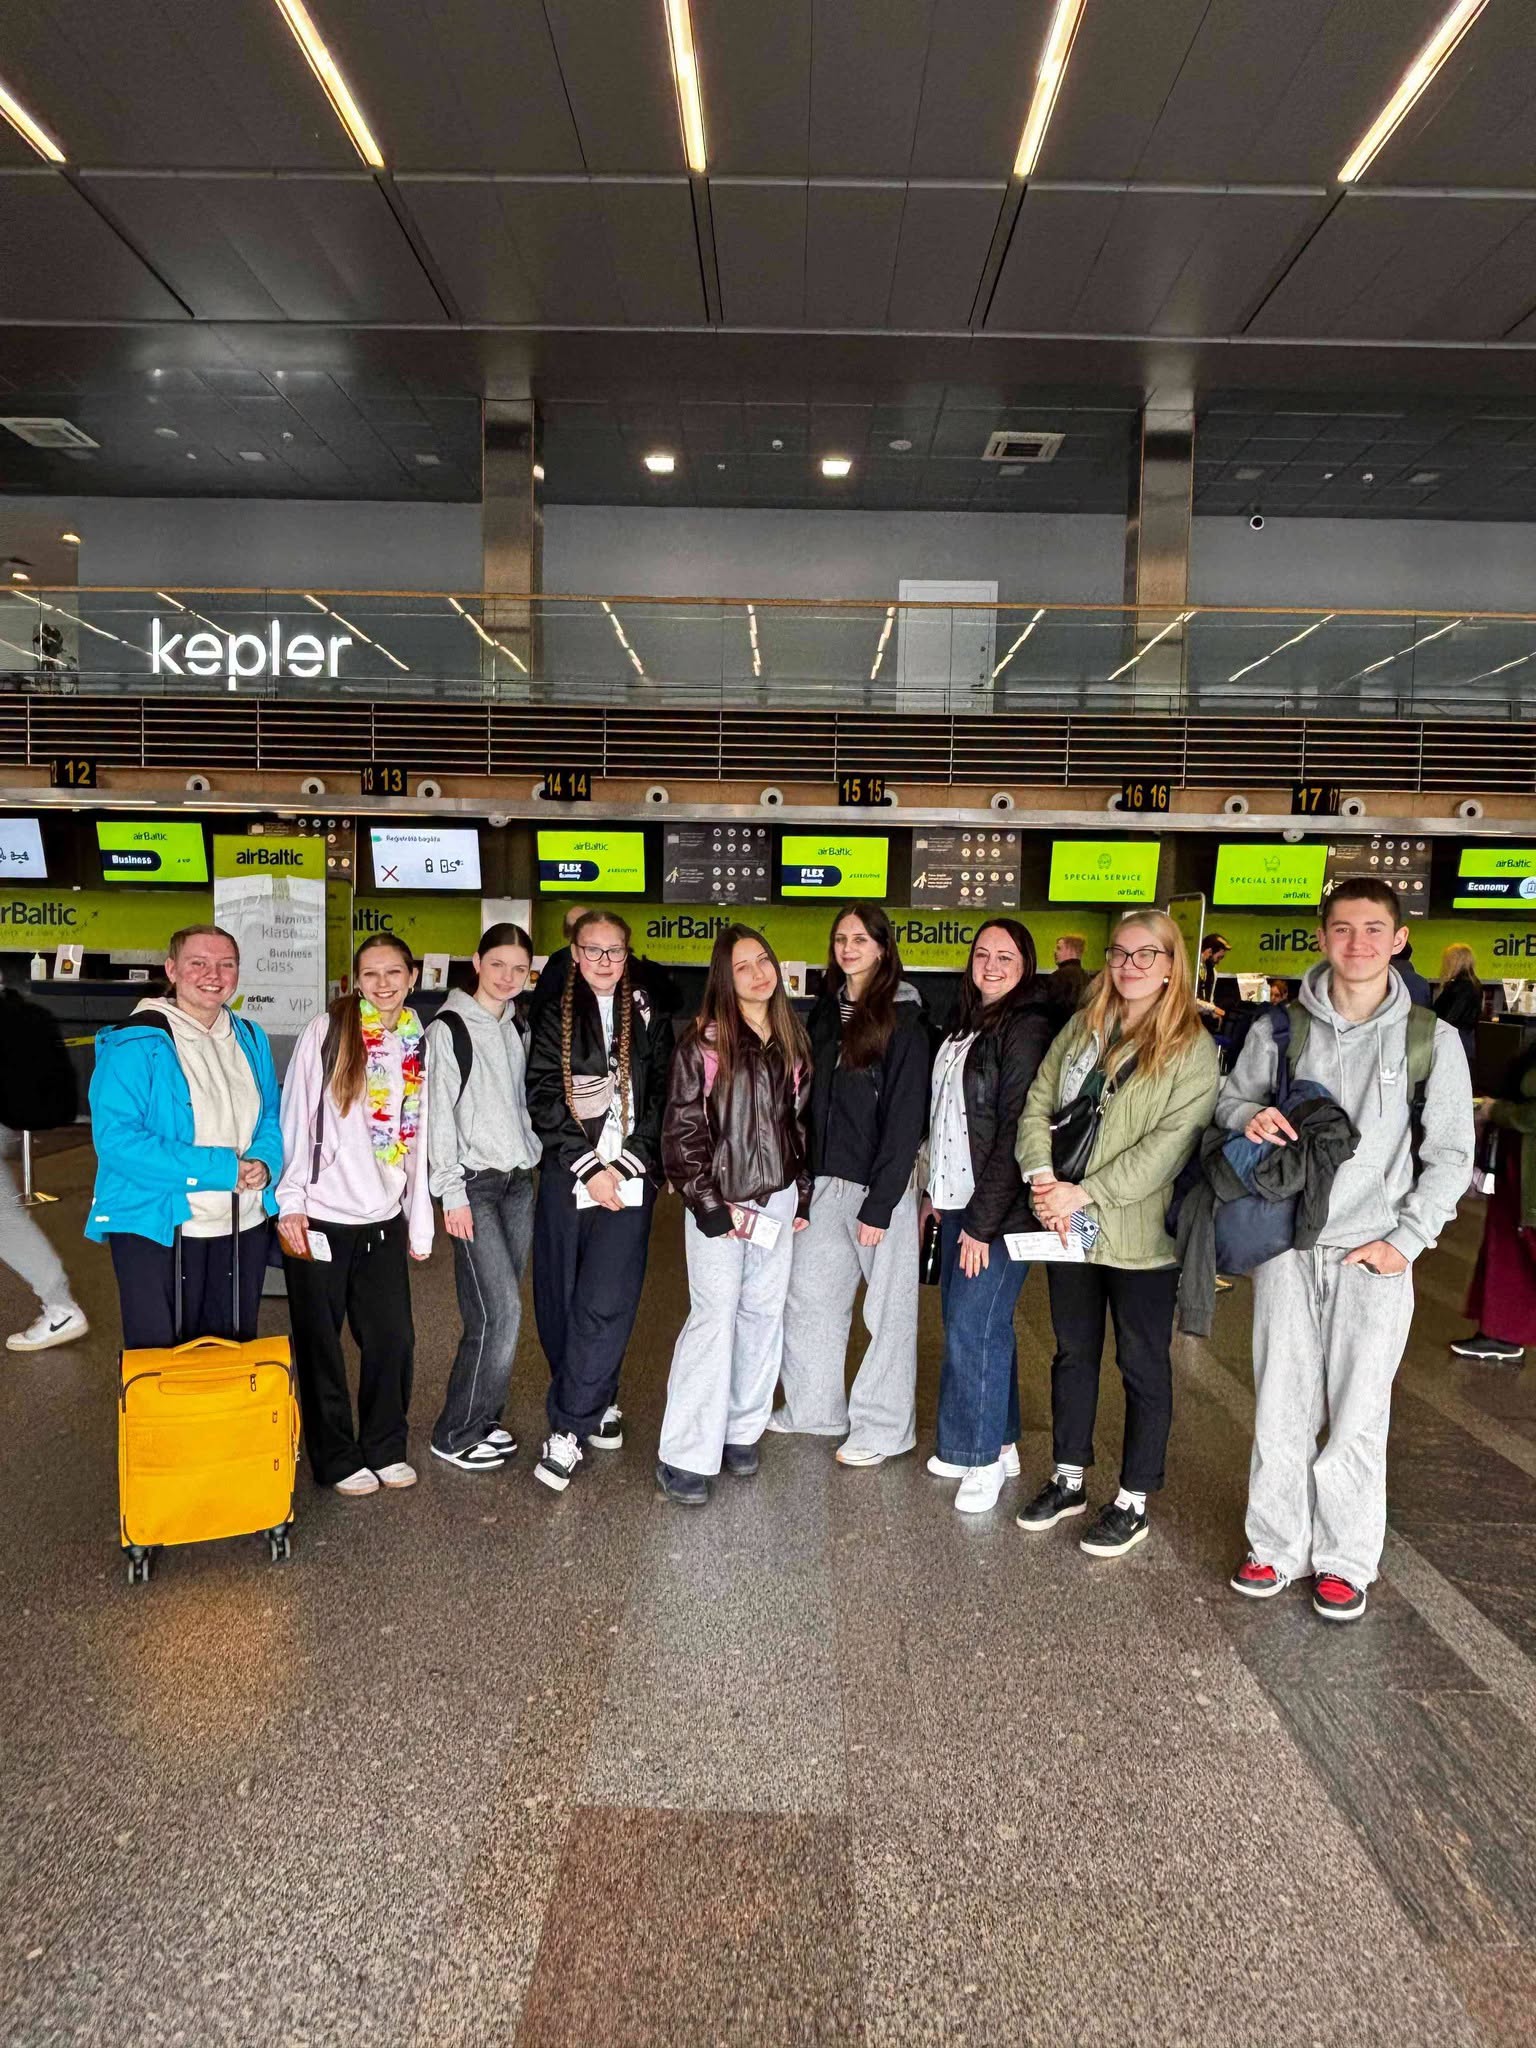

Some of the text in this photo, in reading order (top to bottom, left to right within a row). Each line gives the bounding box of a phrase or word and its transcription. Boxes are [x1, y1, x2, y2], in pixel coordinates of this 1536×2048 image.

[151, 617, 353, 692] kepler
[65, 760, 91, 785] 12
[363, 767, 374, 791] 13
[381, 768, 403, 792] 13
[547, 772, 562, 796] 14
[569, 774, 587, 798] 14
[843, 778, 861, 802] 15
[868, 779, 883, 802] 15
[1126, 783, 1143, 808] 16
[1150, 784, 1167, 809] 16
[1298, 788, 1323, 811] 17
[133, 831, 168, 841] airBaltic
[573, 841, 608, 851] airBaltic
[111, 854, 152, 865] Business
[236, 848, 304, 866] airBaltic
[817, 846, 853, 857] airBaltic
[558, 863, 582, 873] FLEX
[801, 868, 825, 878] FLEX
[1495, 859, 1532, 868] airBaltic
[1064, 873, 1142, 882] SPECIAL SERVICE
[1229, 876, 1308, 885] SPECIAL SERVICE
[1467, 882, 1510, 893] Economy
[353, 908, 394, 932] ltic
[889, 920, 974, 945] rBaltic
[1258, 928, 1322, 953] airBa
[269, 948, 313, 959] Business
[256, 958, 294, 973] Class
[289, 997, 314, 1014] VIP
